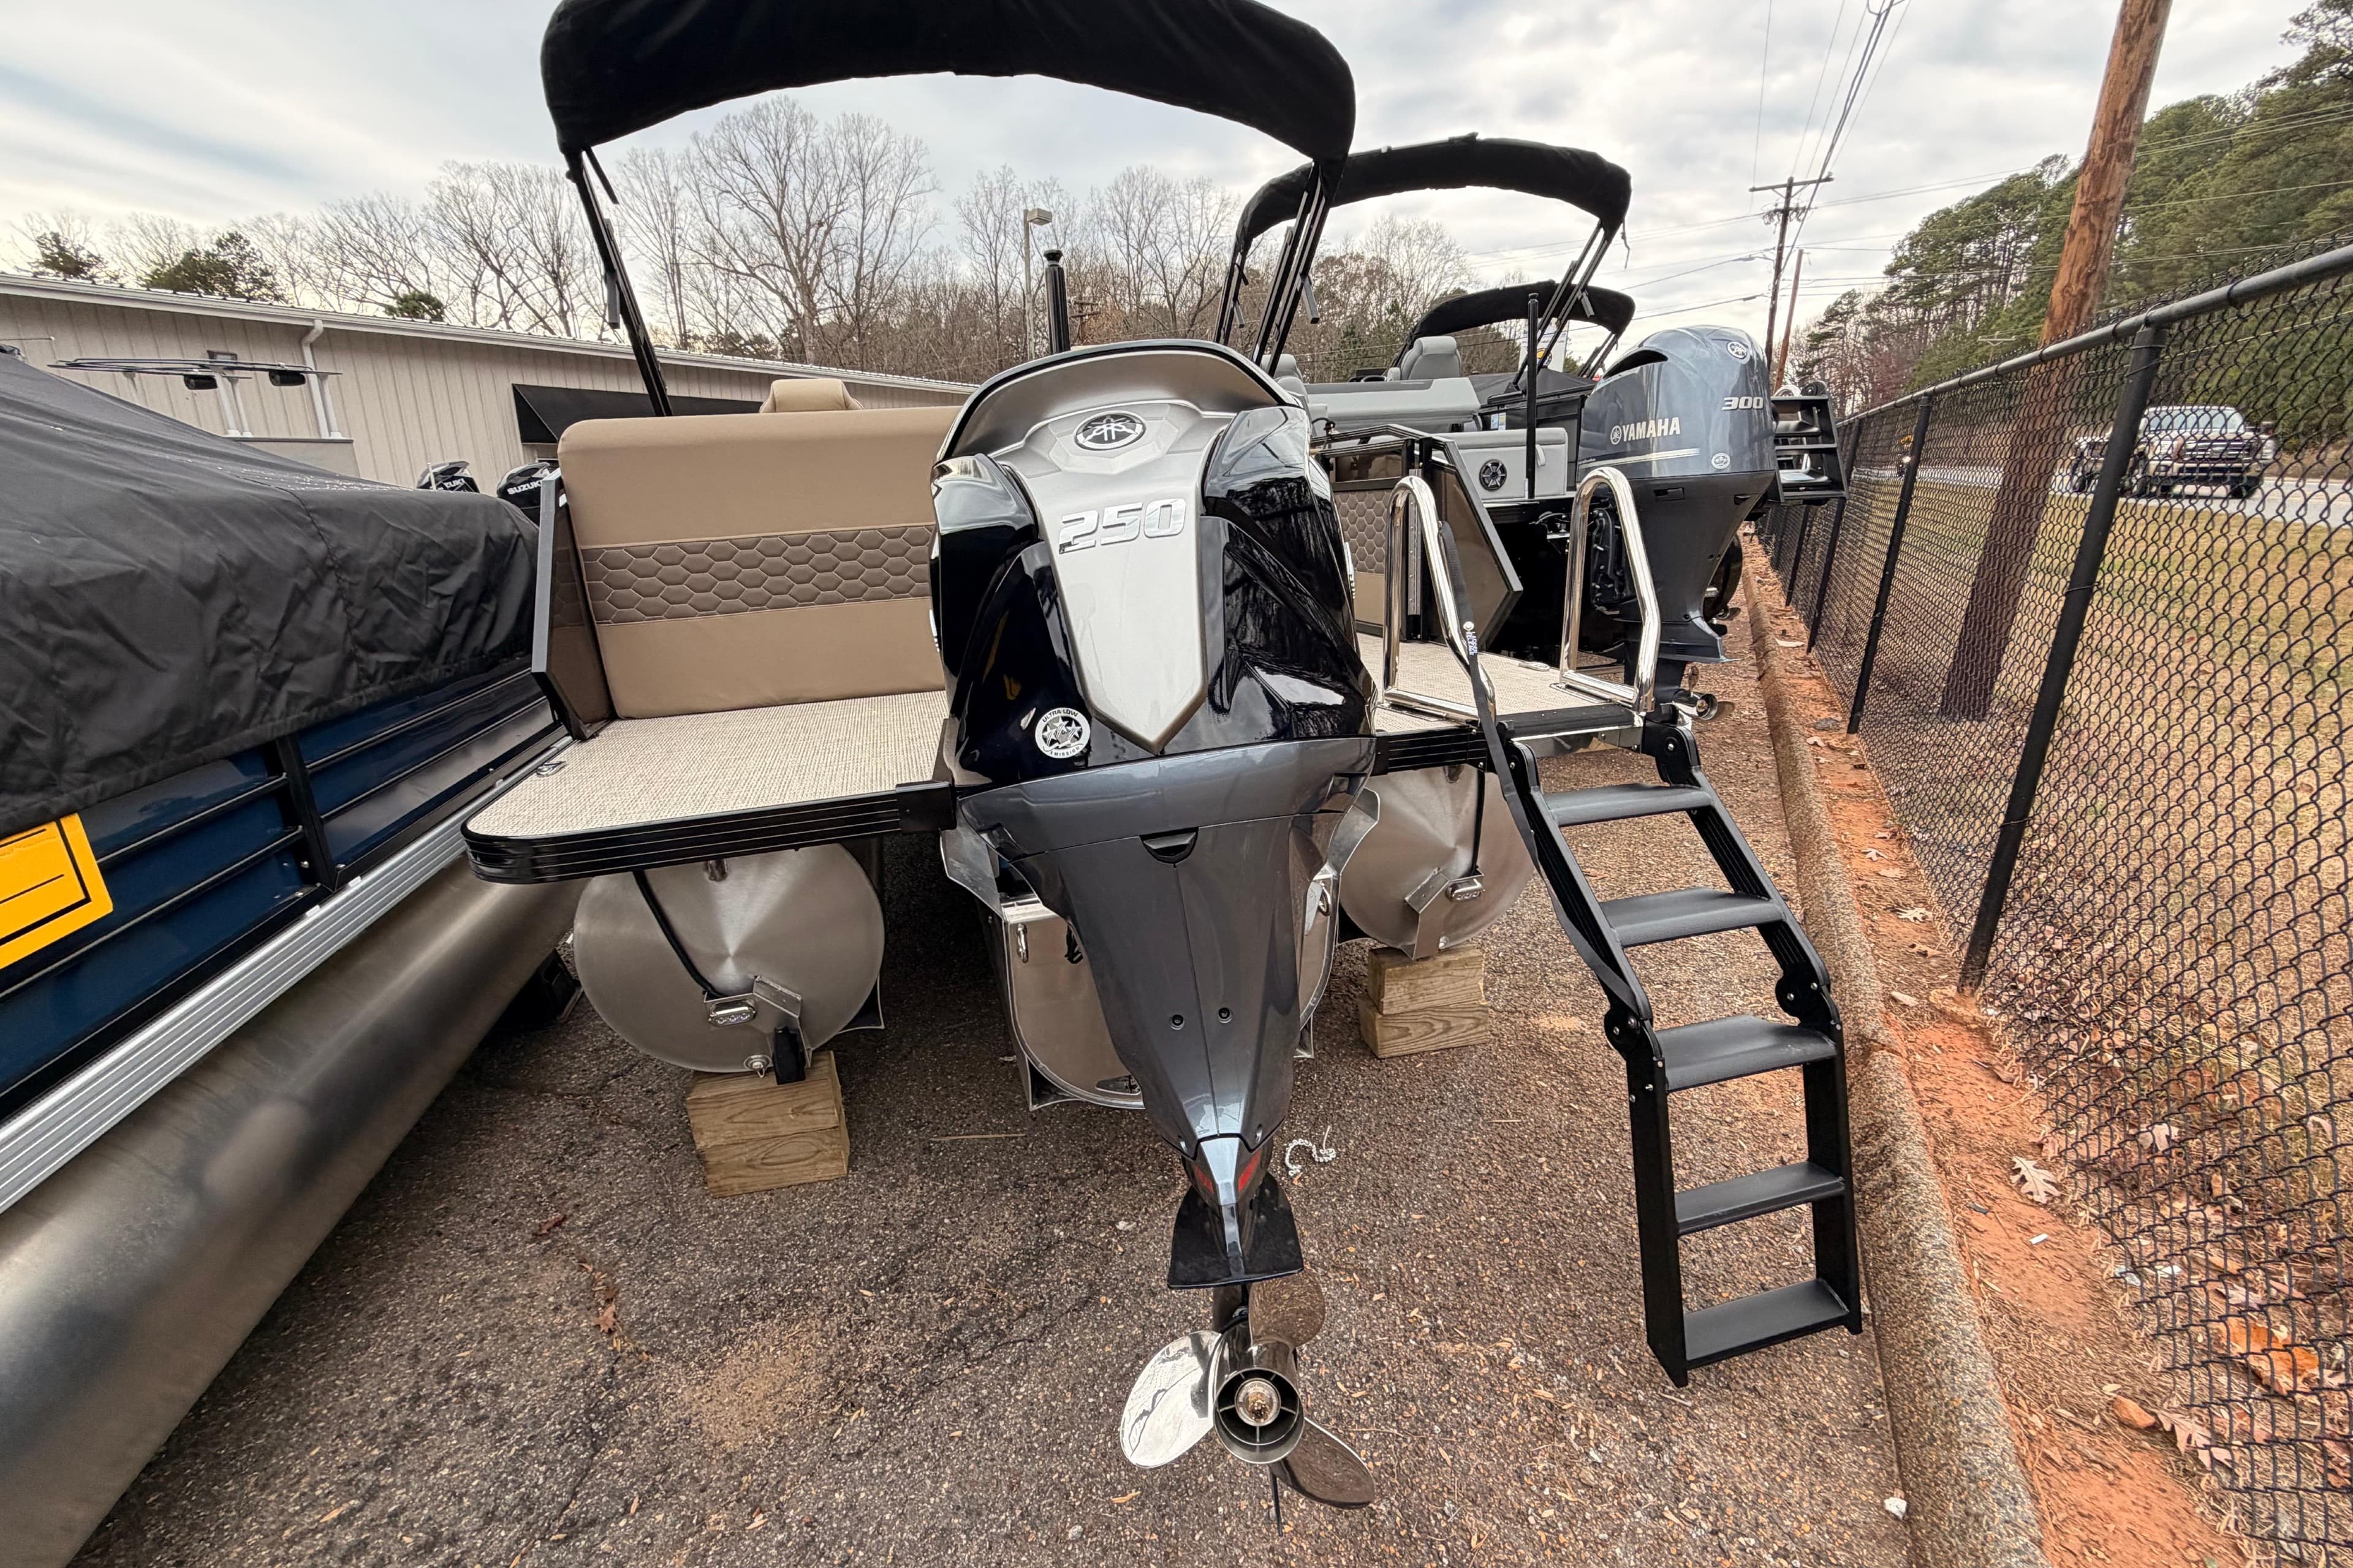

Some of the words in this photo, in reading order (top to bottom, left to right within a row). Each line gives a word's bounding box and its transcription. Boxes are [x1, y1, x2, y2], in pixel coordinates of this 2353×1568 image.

[1722, 396, 1764, 411] 300
[1623, 417, 1680, 442] YAMAHA
[1059, 498, 1186, 554] 250
[1042, 710, 1061, 722] ULTRA
[1050, 746, 1080, 756] EMISSION
